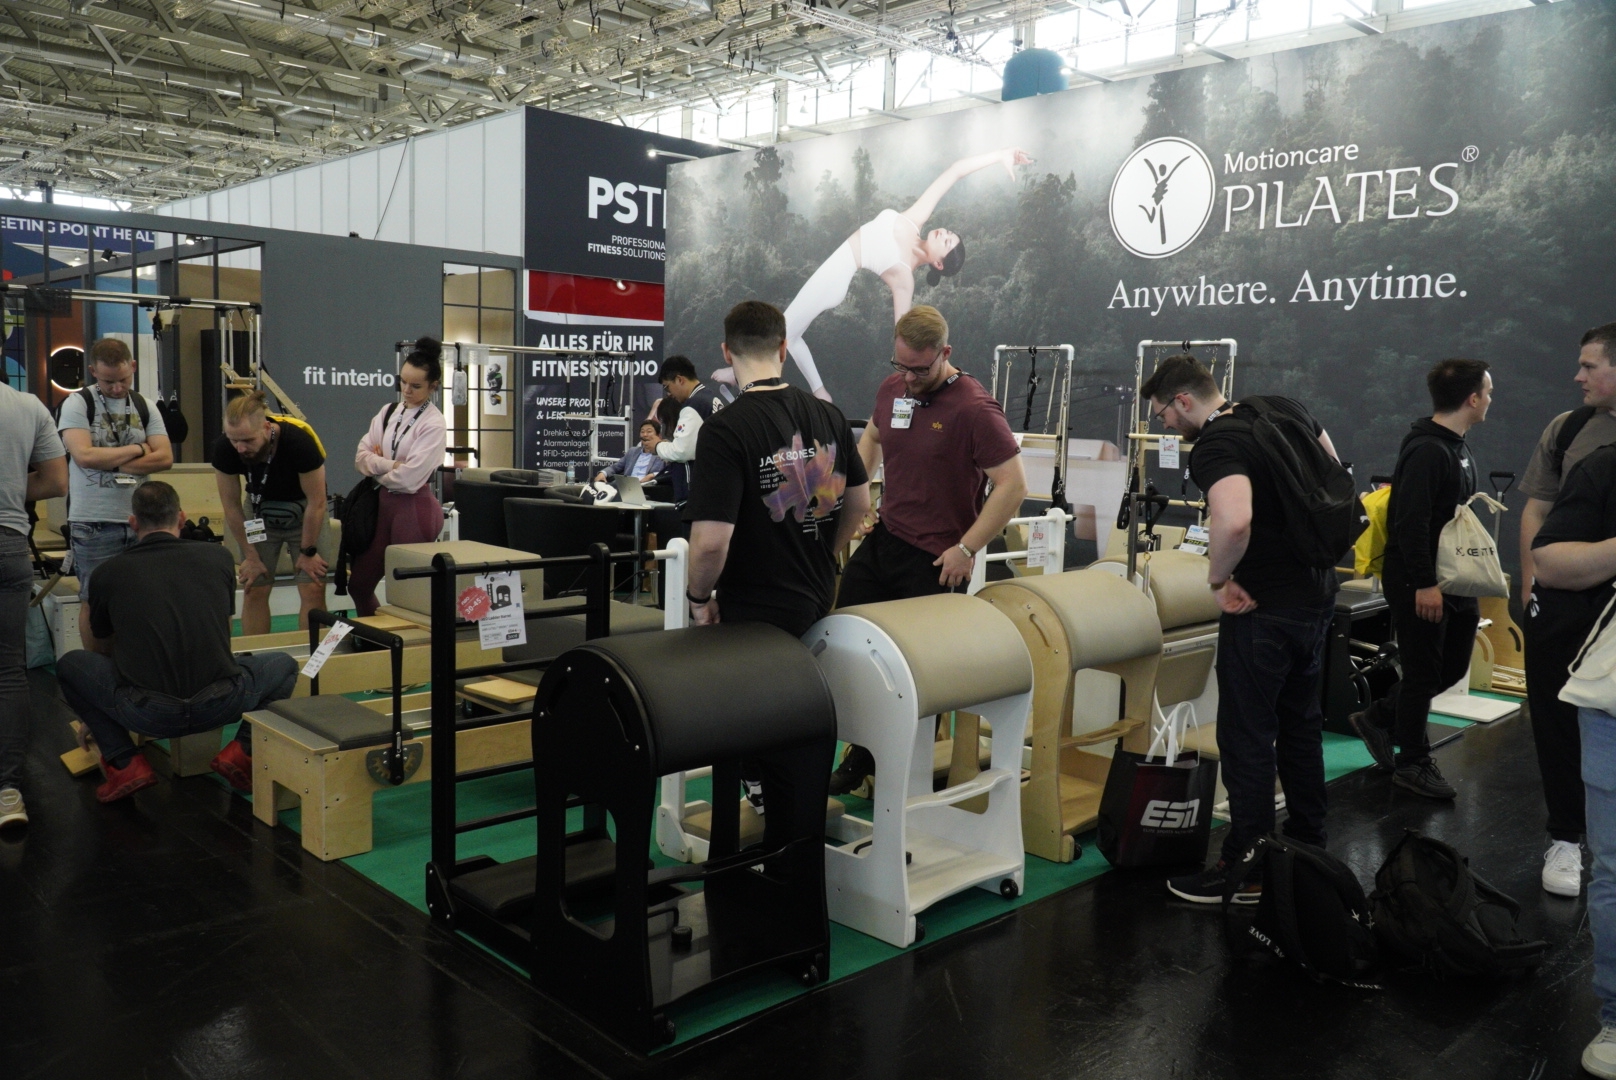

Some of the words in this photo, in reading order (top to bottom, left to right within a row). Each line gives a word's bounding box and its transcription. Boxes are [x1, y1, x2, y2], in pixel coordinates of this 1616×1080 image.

[1224, 143, 1359, 174] Motioncare
[60, 222, 109, 239] POINT
[588, 243, 622, 255] FITNESS
[622, 249, 666, 261] SOLUTIONS
[1107, 275, 1276, 317] Anywhere.
[1289, 264, 1468, 311] Anytime.
[539, 334, 588, 350] ALLES
[593, 331, 622, 351] FÜR
[628, 335, 654, 351] IHR
[303, 366, 326, 385] fit
[536, 397, 567, 407] UNSERE
[536, 411, 544, 420] &
